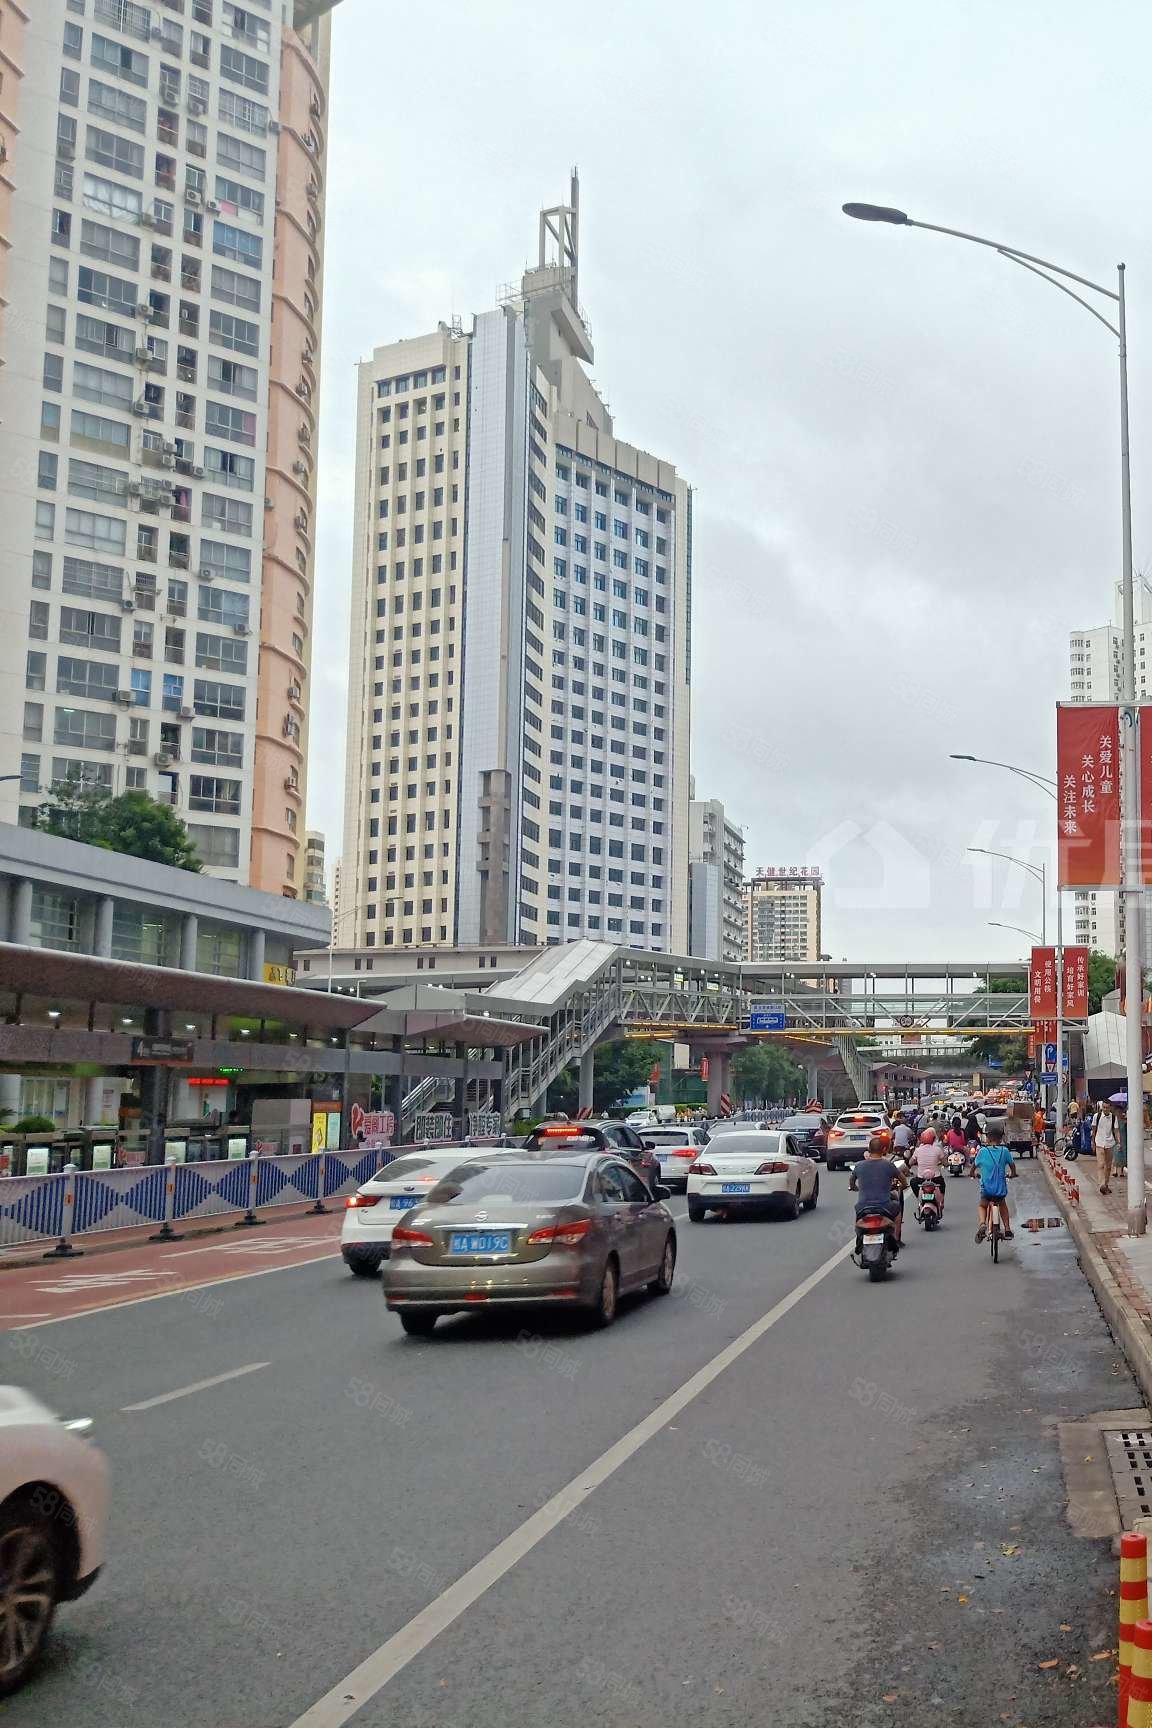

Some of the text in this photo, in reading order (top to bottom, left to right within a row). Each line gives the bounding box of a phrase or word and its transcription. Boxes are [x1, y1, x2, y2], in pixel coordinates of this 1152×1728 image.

[1081, 754, 1095, 814] 关心成长
[1099, 735, 1113, 794] 关爱儿童
[1063, 774, 1077, 835] 关注未来
[756, 865, 820, 877] 天健世纪花园
[1033, 970, 1042, 1004] 文明用餐
[1066, 966, 1075, 1008] 培育好家风
